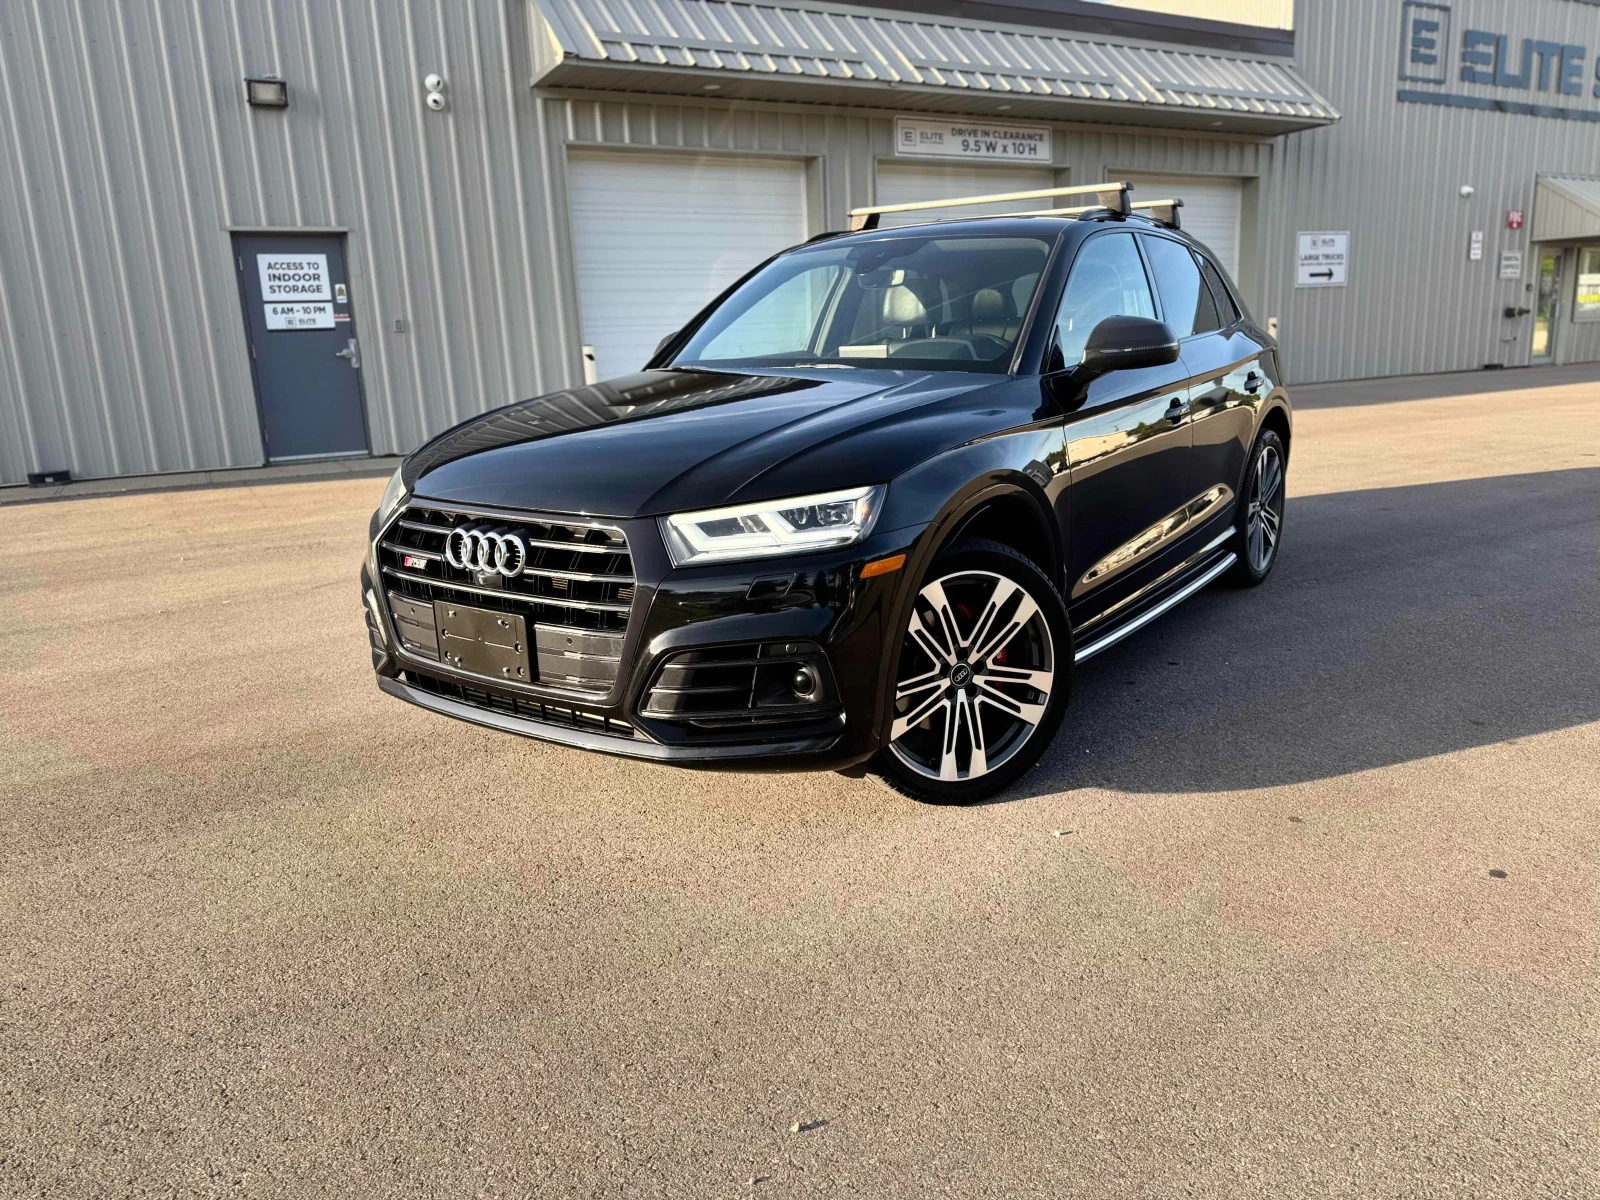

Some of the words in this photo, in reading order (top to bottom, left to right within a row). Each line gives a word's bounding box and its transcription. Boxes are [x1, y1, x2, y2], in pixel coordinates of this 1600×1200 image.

[1461, 29, 1586, 96] ELITE
[919, 131, 944, 141] ELITE
[951, 127, 979, 138] DRIVE
[981, 130, 990, 138] IN
[992, 131, 1044, 142] CLEARANCE
[267, 261, 304, 270] ACCESS
[306, 261, 320, 271] TO
[268, 273, 321, 282] INDOOR
[269, 284, 323, 294] STORAGE
[272, 307, 279, 315] 6
[280, 307, 294, 315] AM
[301, 306, 312, 315] 10
[313, 306, 326, 314] PM
